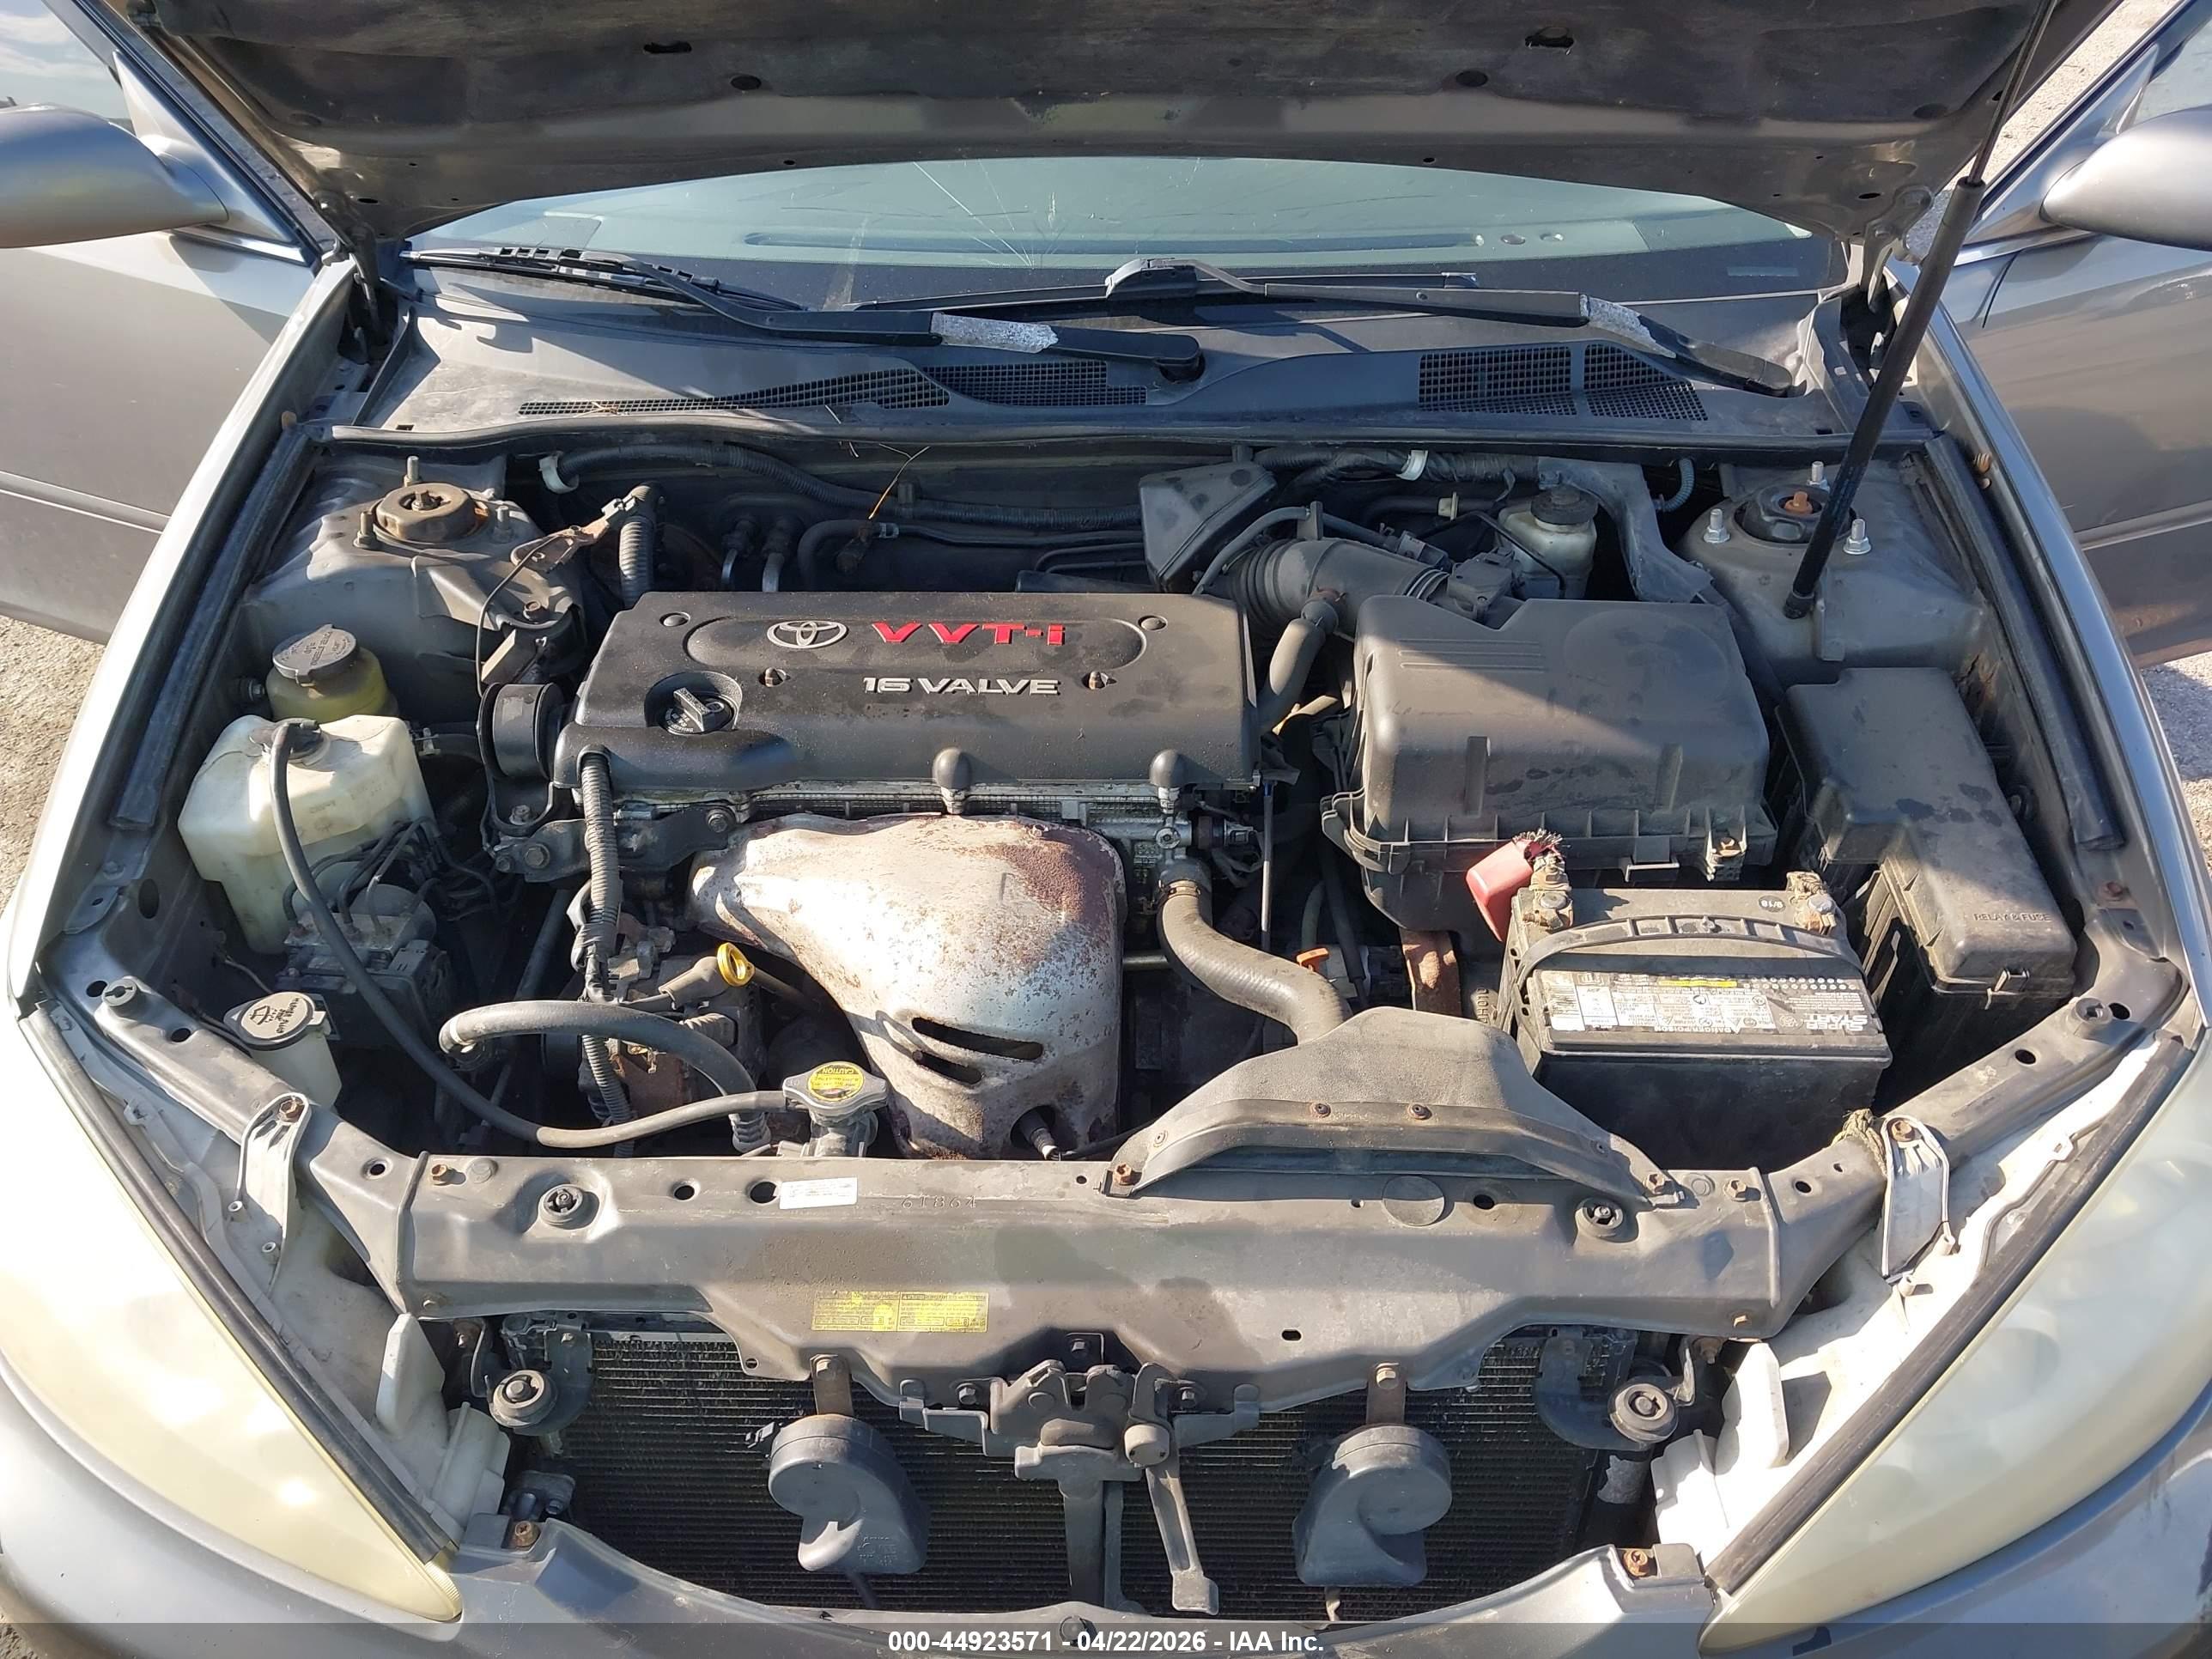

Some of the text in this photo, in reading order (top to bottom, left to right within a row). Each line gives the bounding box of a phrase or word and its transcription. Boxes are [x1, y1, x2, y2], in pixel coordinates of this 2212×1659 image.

[872, 623, 1066, 646] VVT-i
[864, 678, 1061, 696] 16 VALVE
[1973, 913, 2008, 921] RELAY
[2021, 913, 2052, 922] FUSE
[1803, 1014, 1869, 1025] START
[1806, 1022, 1863, 1031] SUPER
